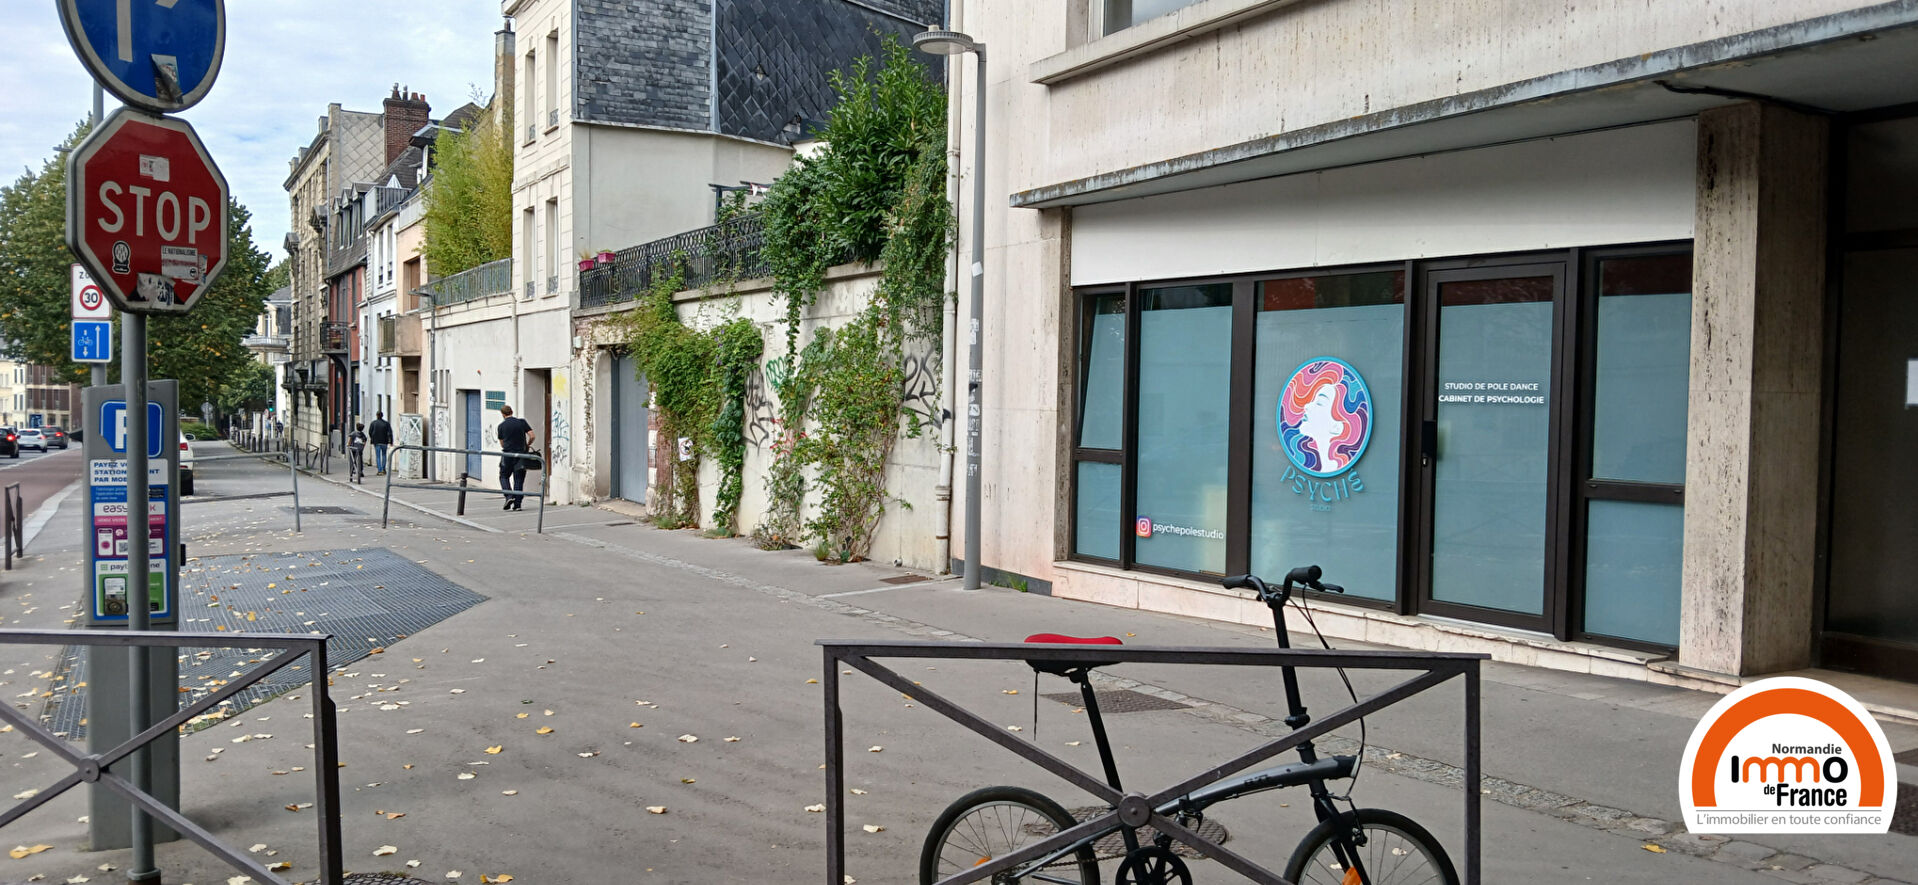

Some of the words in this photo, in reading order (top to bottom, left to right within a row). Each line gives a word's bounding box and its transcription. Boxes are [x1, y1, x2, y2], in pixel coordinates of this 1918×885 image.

[97, 180, 211, 244] STOP
[84, 292, 98, 303] 30
[1445, 382, 1473, 390] STUDIO
[1475, 382, 1486, 390] DE
[1487, 383, 1508, 391] POLE
[1510, 383, 1539, 391] DANCE
[1438, 394, 1472, 403] CABINET
[1474, 395, 1485, 403] DE
[1487, 395, 1545, 404] PSYCHOLOGIE
[1152, 523, 1225, 539] psychepolestudio
